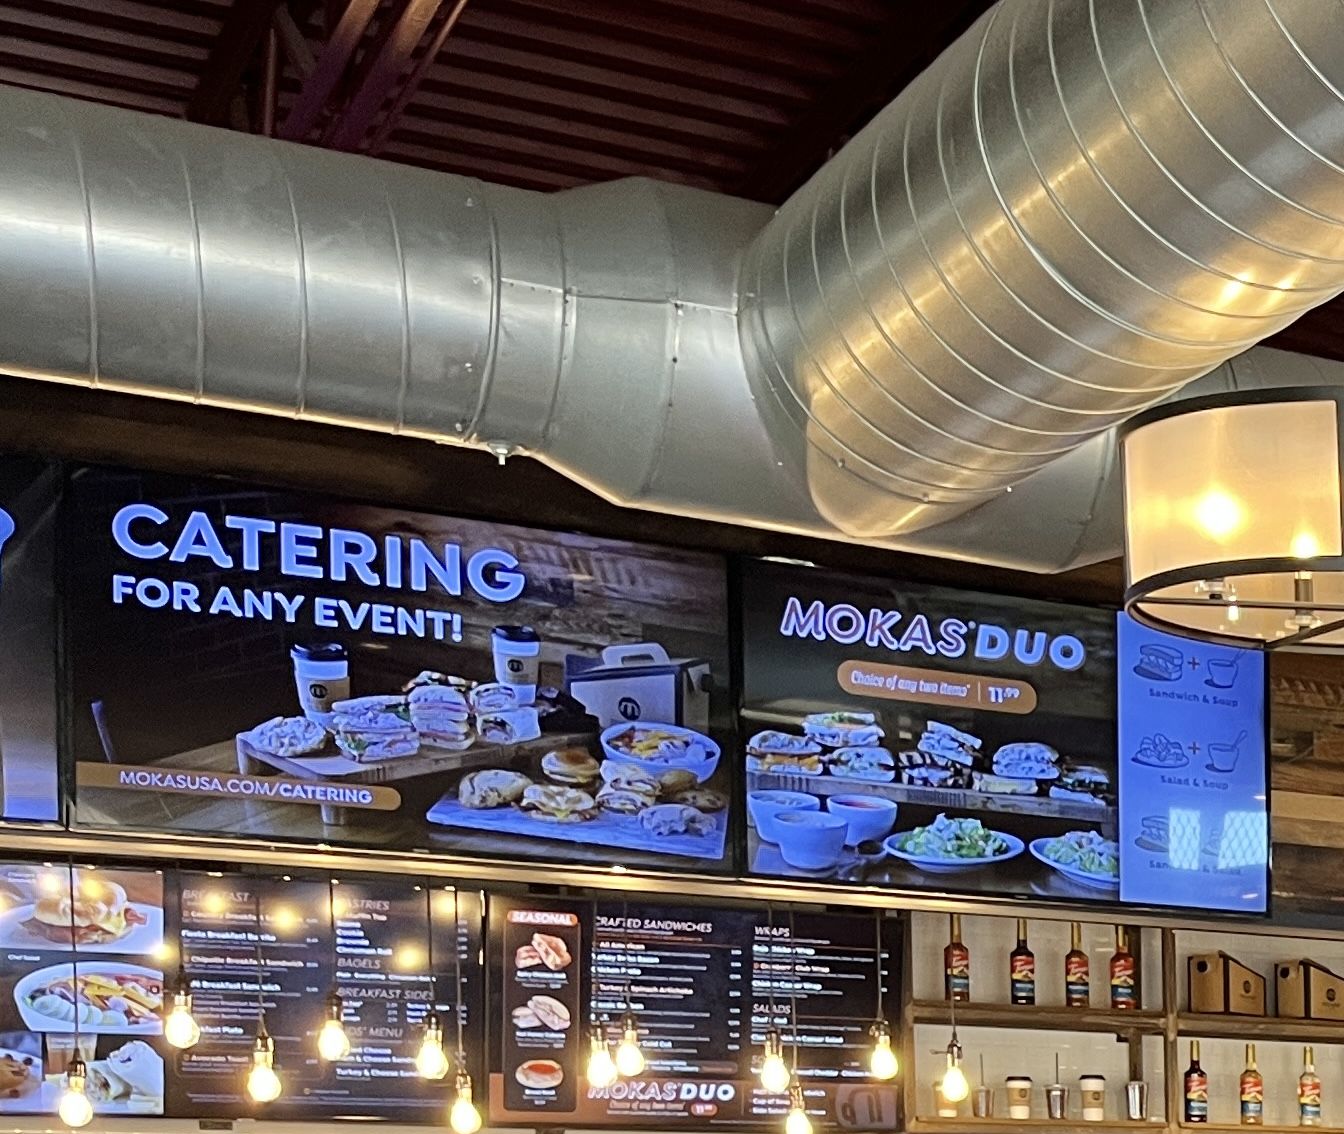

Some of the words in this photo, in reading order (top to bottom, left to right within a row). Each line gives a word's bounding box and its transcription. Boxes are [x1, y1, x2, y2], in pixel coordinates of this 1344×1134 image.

[111, 503, 526, 601] CATERING
[112, 574, 201, 613] FOR
[209, 586, 305, 623] ANY
[314, 597, 463, 642] EVENT!
[973, 624, 1086, 671] DUO
[1149, 688, 1200, 704] Sandwich
[1202, 694, 1210, 703] &
[1212, 695, 1239, 708] Soup
[119, 770, 373, 804] MOKASUSA.COM/CATERING
[1160, 774, 1190, 787] Salad
[1203, 778, 1229, 790] Soup
[512, 911, 573, 925] SEASONAL
[643, 919, 712, 933] SANDWICHES
[337, 957, 381, 970] BAGELS
[336, 986, 402, 998] BREAKFAST
[752, 1003, 791, 1015] SALADS
[369, 1027, 403, 1038] MENU
[679, 1083, 736, 1101] DUO
